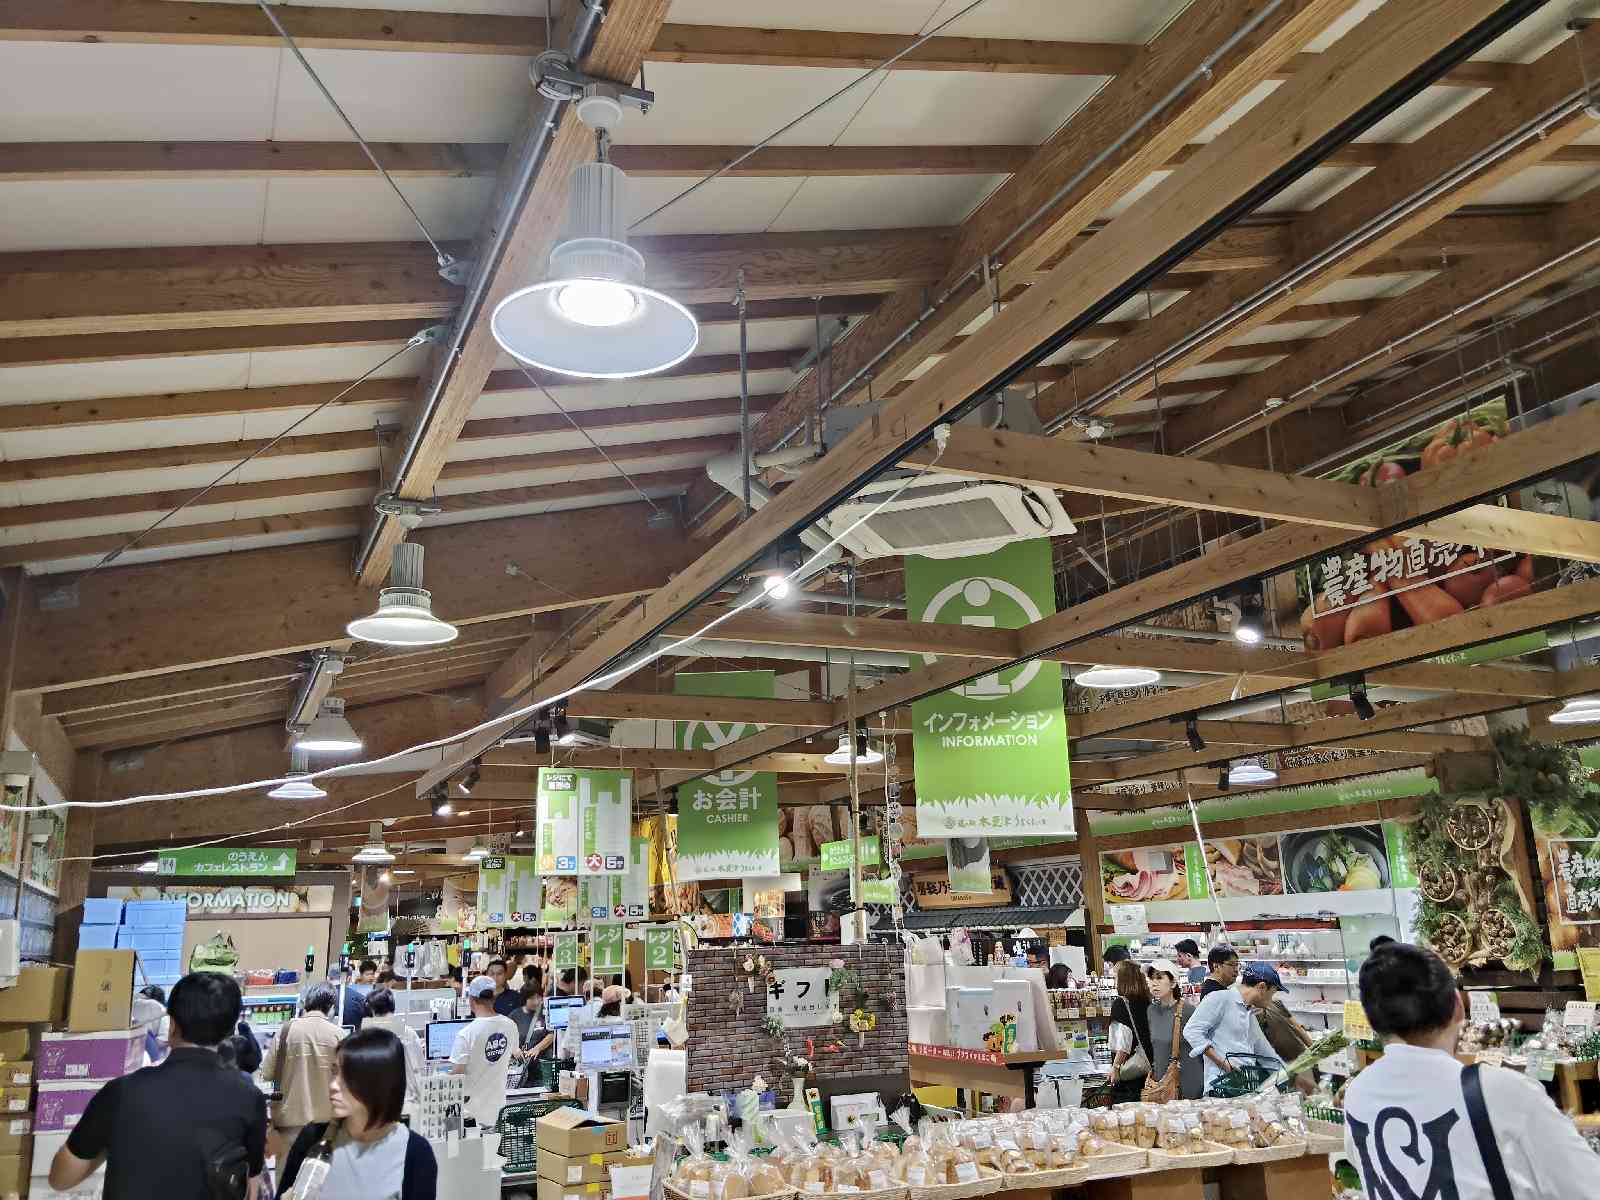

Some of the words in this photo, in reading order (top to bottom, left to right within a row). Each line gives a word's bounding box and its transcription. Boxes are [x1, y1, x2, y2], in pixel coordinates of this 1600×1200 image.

[1320, 539, 1484, 607] 農産物直売
[923, 711, 1053, 733] インフォメーション
[942, 734, 1039, 748] INFORMATION
[691, 787, 762, 811] お会計
[706, 813, 748, 824] CASHIER
[194, 863, 268, 873] カフェレストラン
[585, 856, 602, 870] 大
[161, 892, 290, 908] INFORMATION
[614, 905, 626, 916] 大
[595, 927, 621, 943] レジ
[648, 930, 671, 944] レジ
[601, 946, 612, 966] 1
[652, 946, 668, 964] 2
[487, 1038, 506, 1050] ABC
